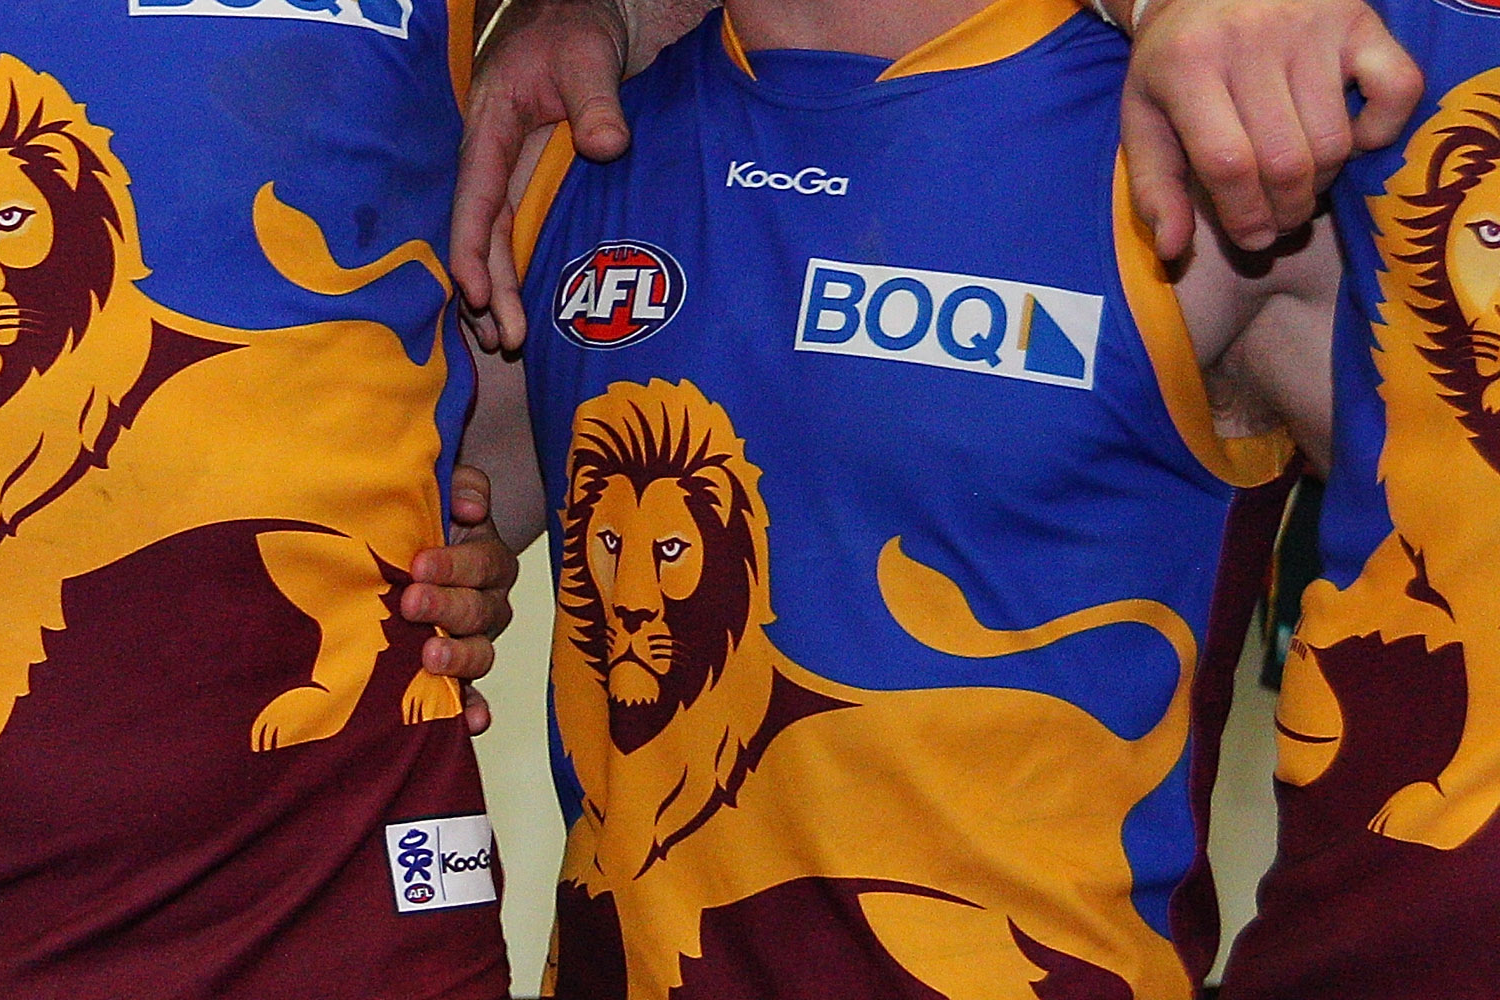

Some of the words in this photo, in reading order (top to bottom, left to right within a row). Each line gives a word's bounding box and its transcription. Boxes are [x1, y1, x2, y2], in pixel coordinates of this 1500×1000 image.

[726, 160, 849, 196] KooGa
[558, 267, 666, 320] AFL
[801, 267, 1008, 369] BOQ
[407, 886, 433, 899] AFL
